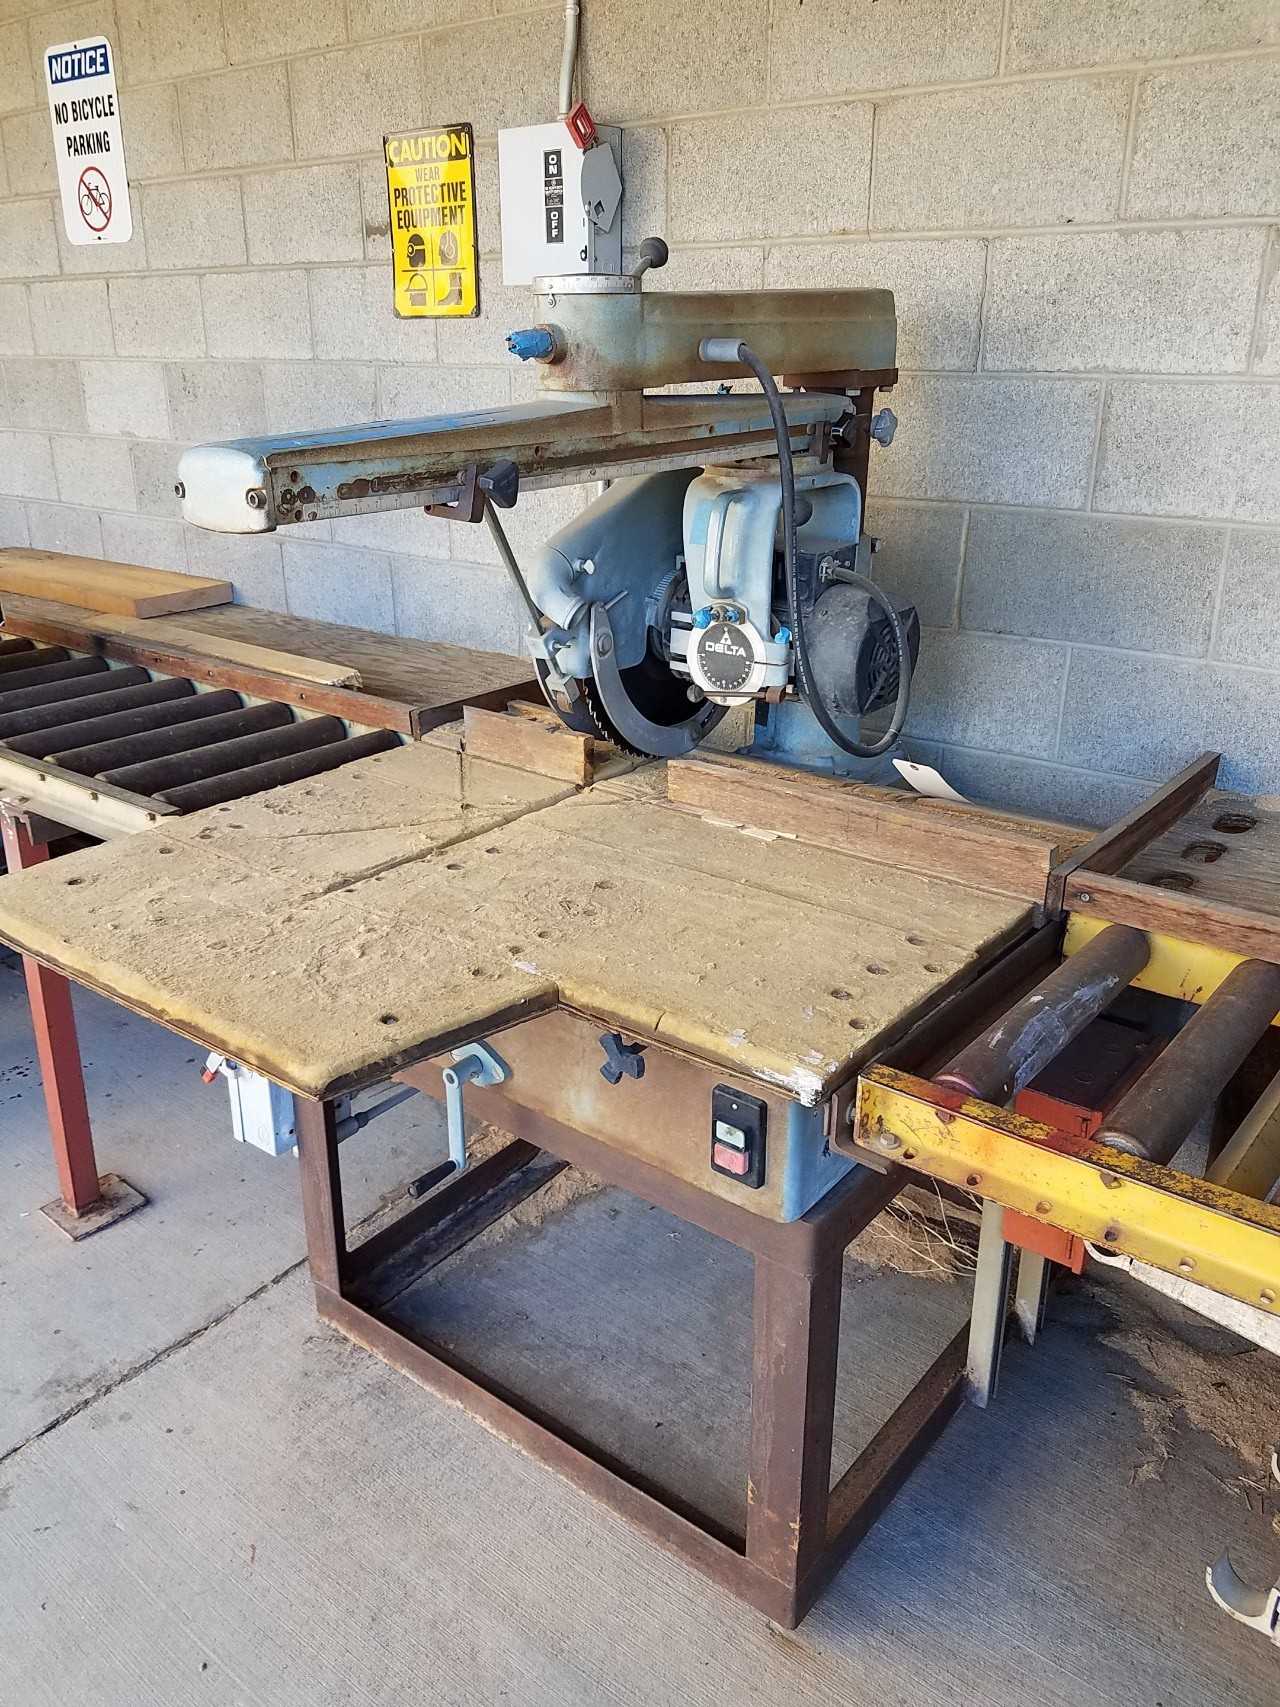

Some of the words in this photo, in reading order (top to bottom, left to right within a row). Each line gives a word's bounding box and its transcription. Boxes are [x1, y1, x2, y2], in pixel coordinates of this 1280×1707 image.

[51, 48, 105, 81] NOTICE
[54, 103, 68, 124] NO
[71, 95, 114, 122] BICYCLE
[66, 131, 110, 157] PARKING
[388, 132, 467, 162] CAUTION
[416, 166, 440, 182] WEAR
[548, 154, 558, 175] ON
[394, 181, 467, 207] PROTECTIVE
[397, 205, 465, 231] EQUIPMENT
[550, 211, 559, 238] OFF
[705, 641, 746, 657] DELTA
